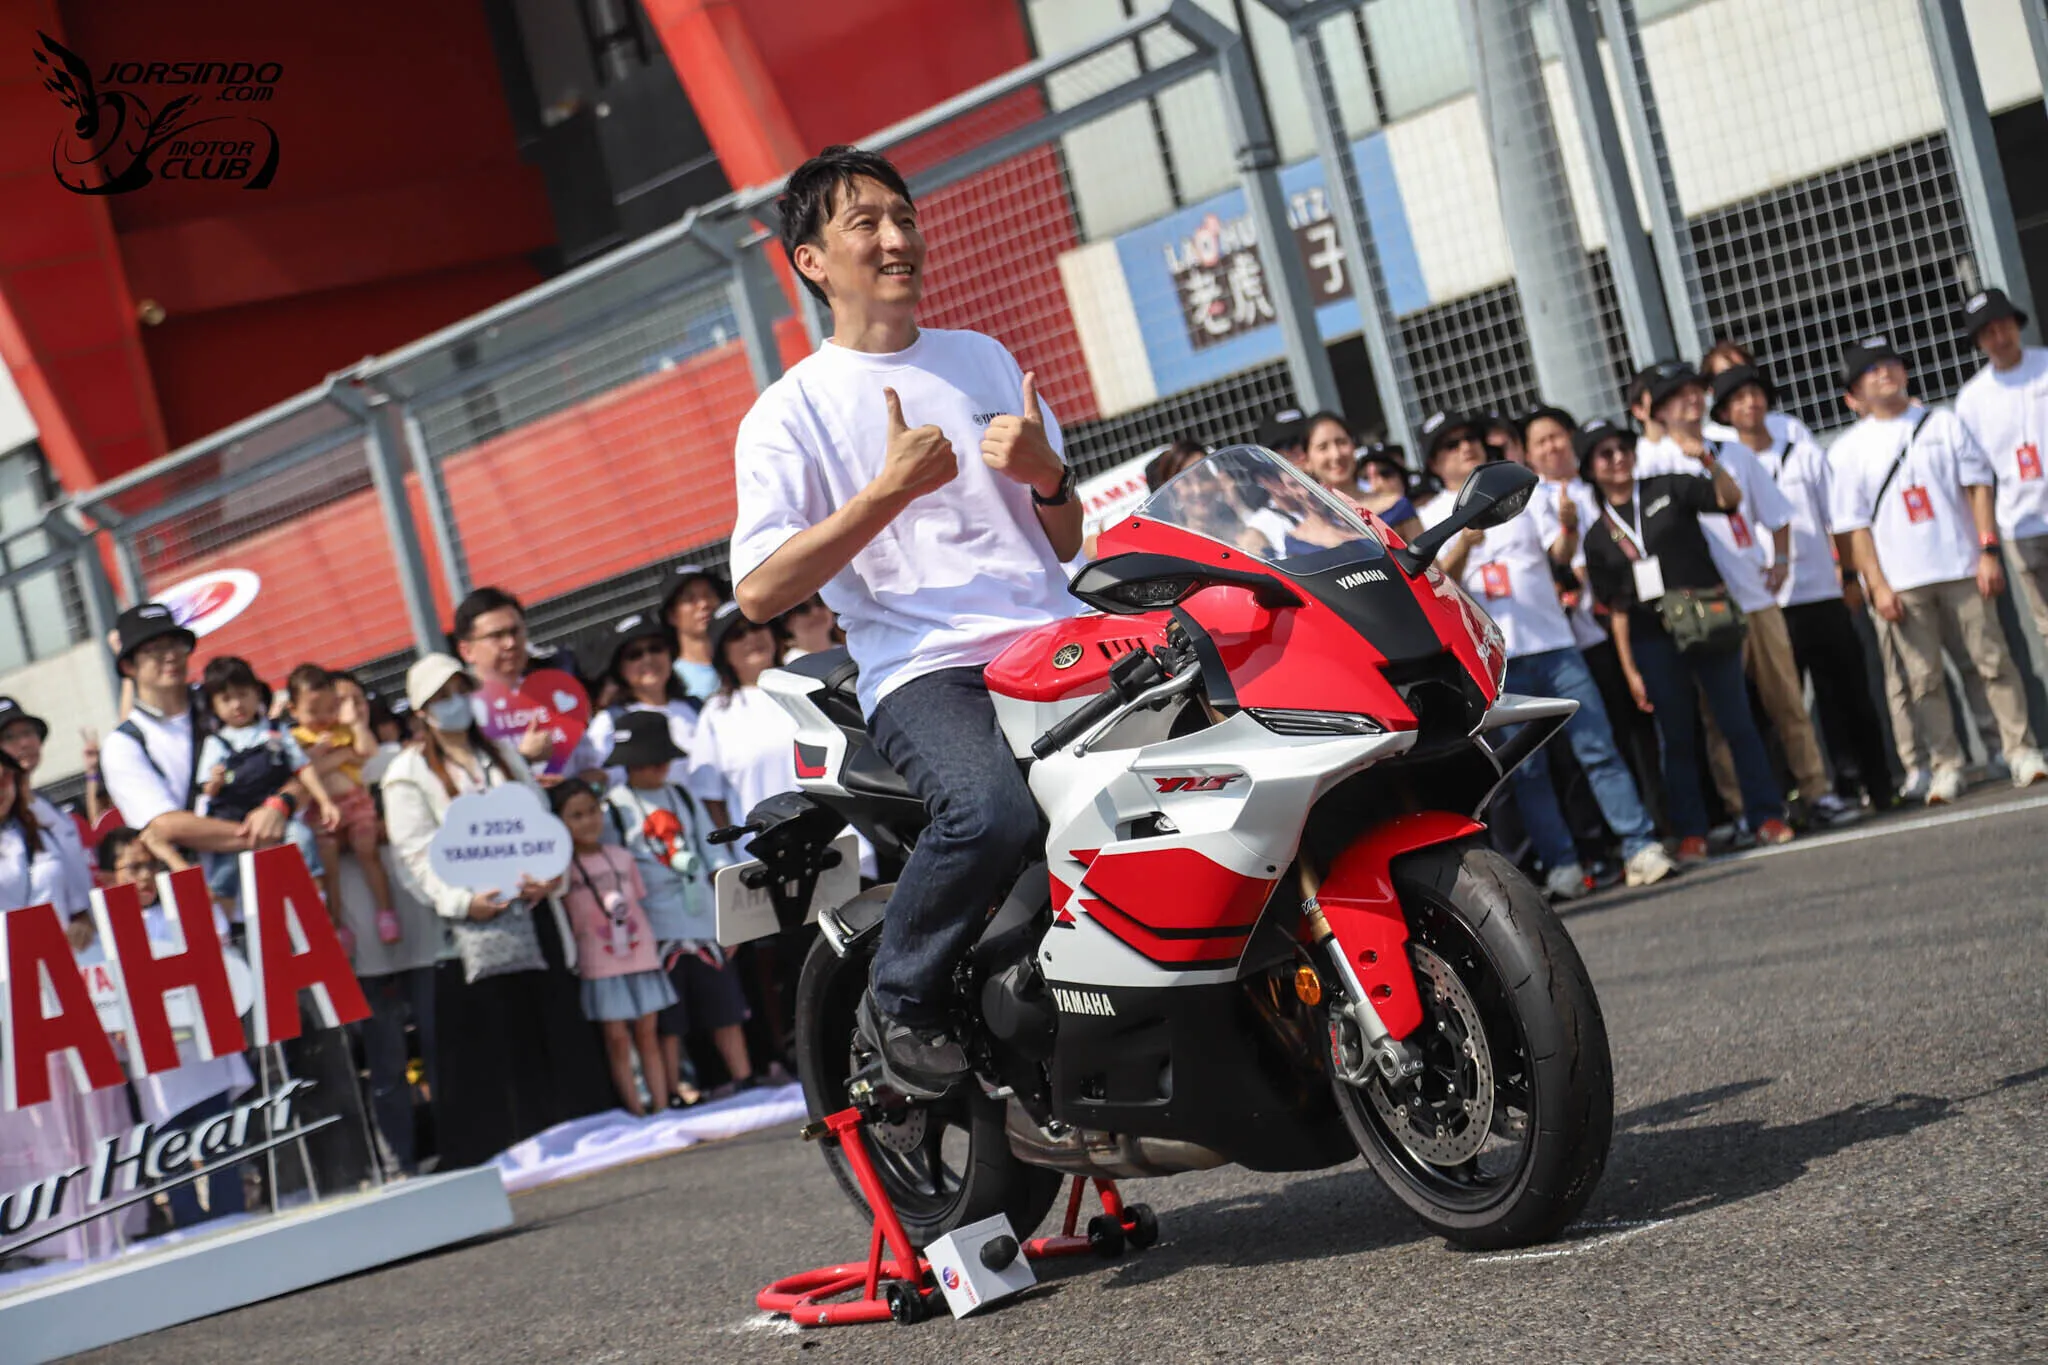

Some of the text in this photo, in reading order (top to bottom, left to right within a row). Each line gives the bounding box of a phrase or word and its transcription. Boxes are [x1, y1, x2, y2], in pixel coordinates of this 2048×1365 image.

[1336, 569, 1389, 591] YAMAHA
[443, 840, 556, 861] YAMAHA DAY
[1052, 988, 1116, 1016] YAMAHA
